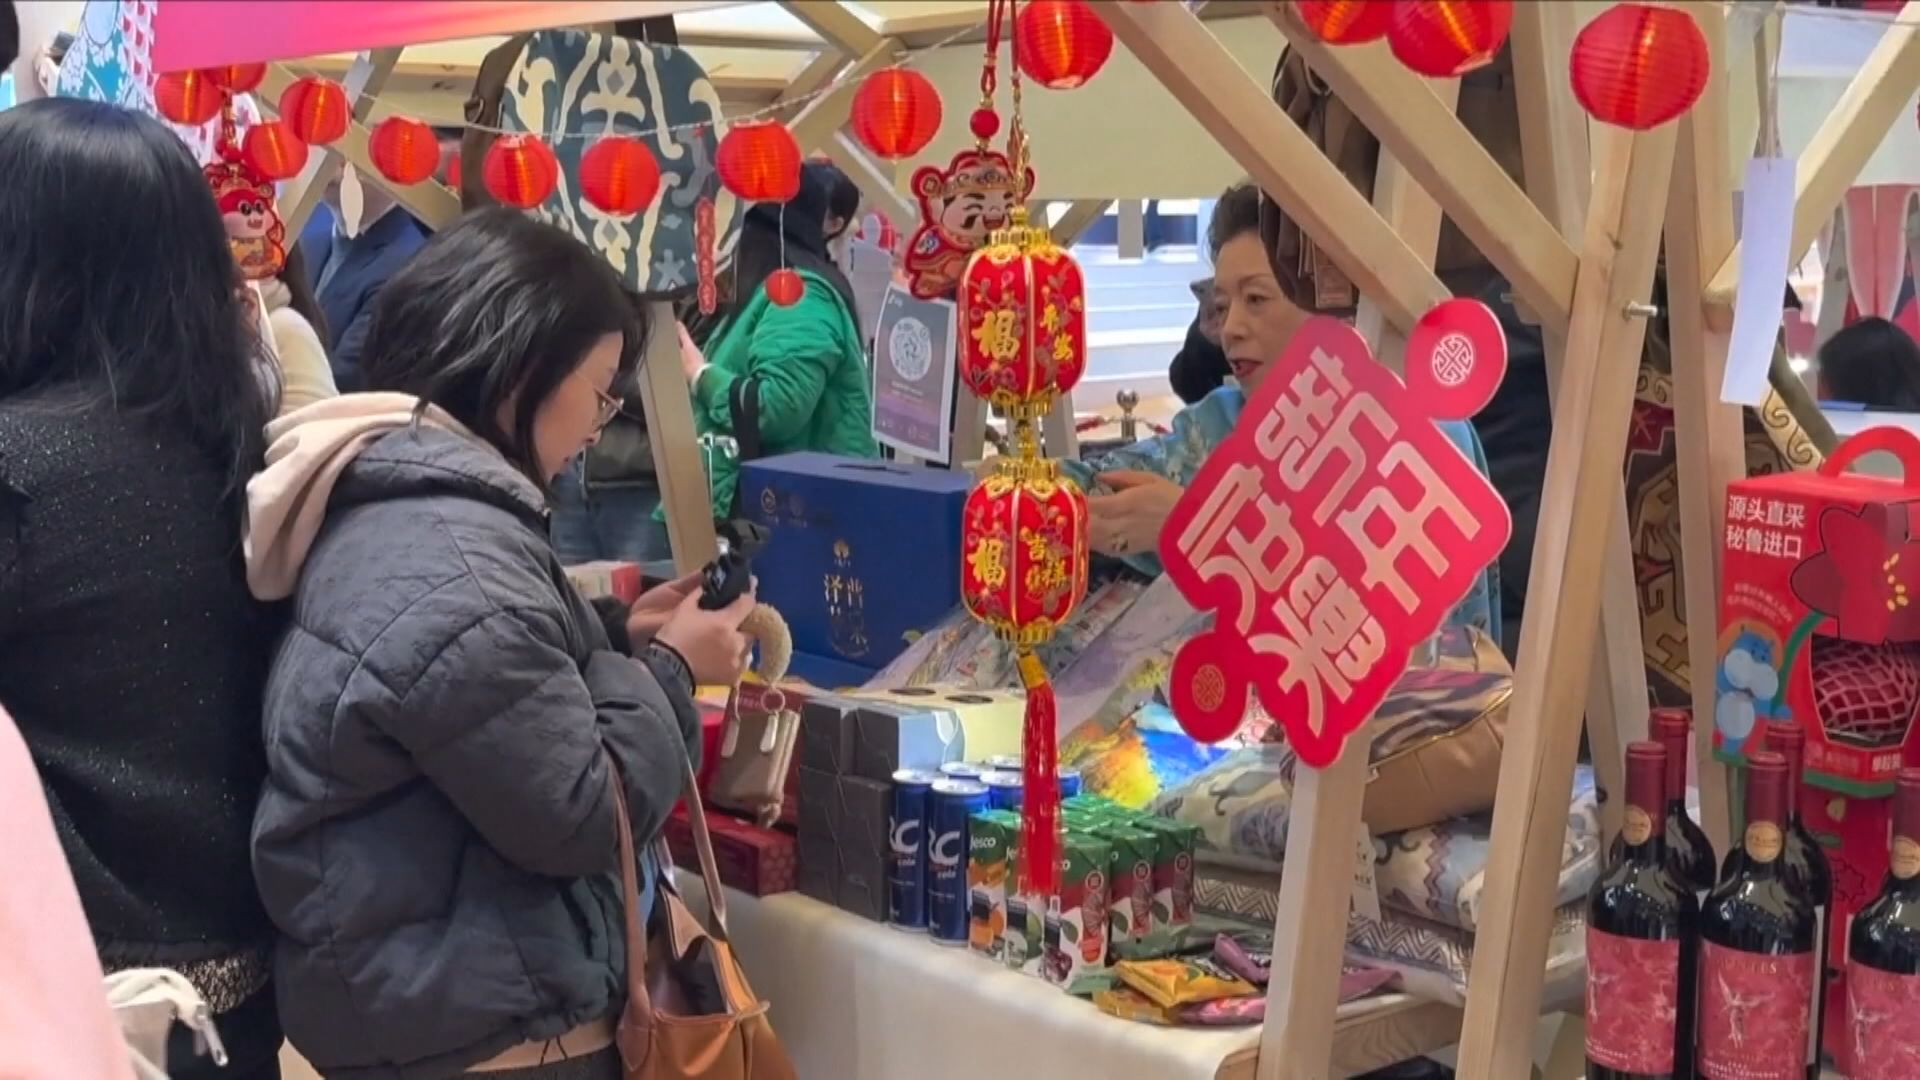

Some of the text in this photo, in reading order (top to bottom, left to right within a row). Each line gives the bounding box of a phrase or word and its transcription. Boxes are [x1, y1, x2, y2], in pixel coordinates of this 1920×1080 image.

[971, 309, 1021, 360] 福
[1255, 346, 1482, 616] 新年
[1728, 495, 1805, 528] 源头直采
[966, 537, 1007, 587] 福
[1726, 525, 1802, 560] 秘鲁进口
